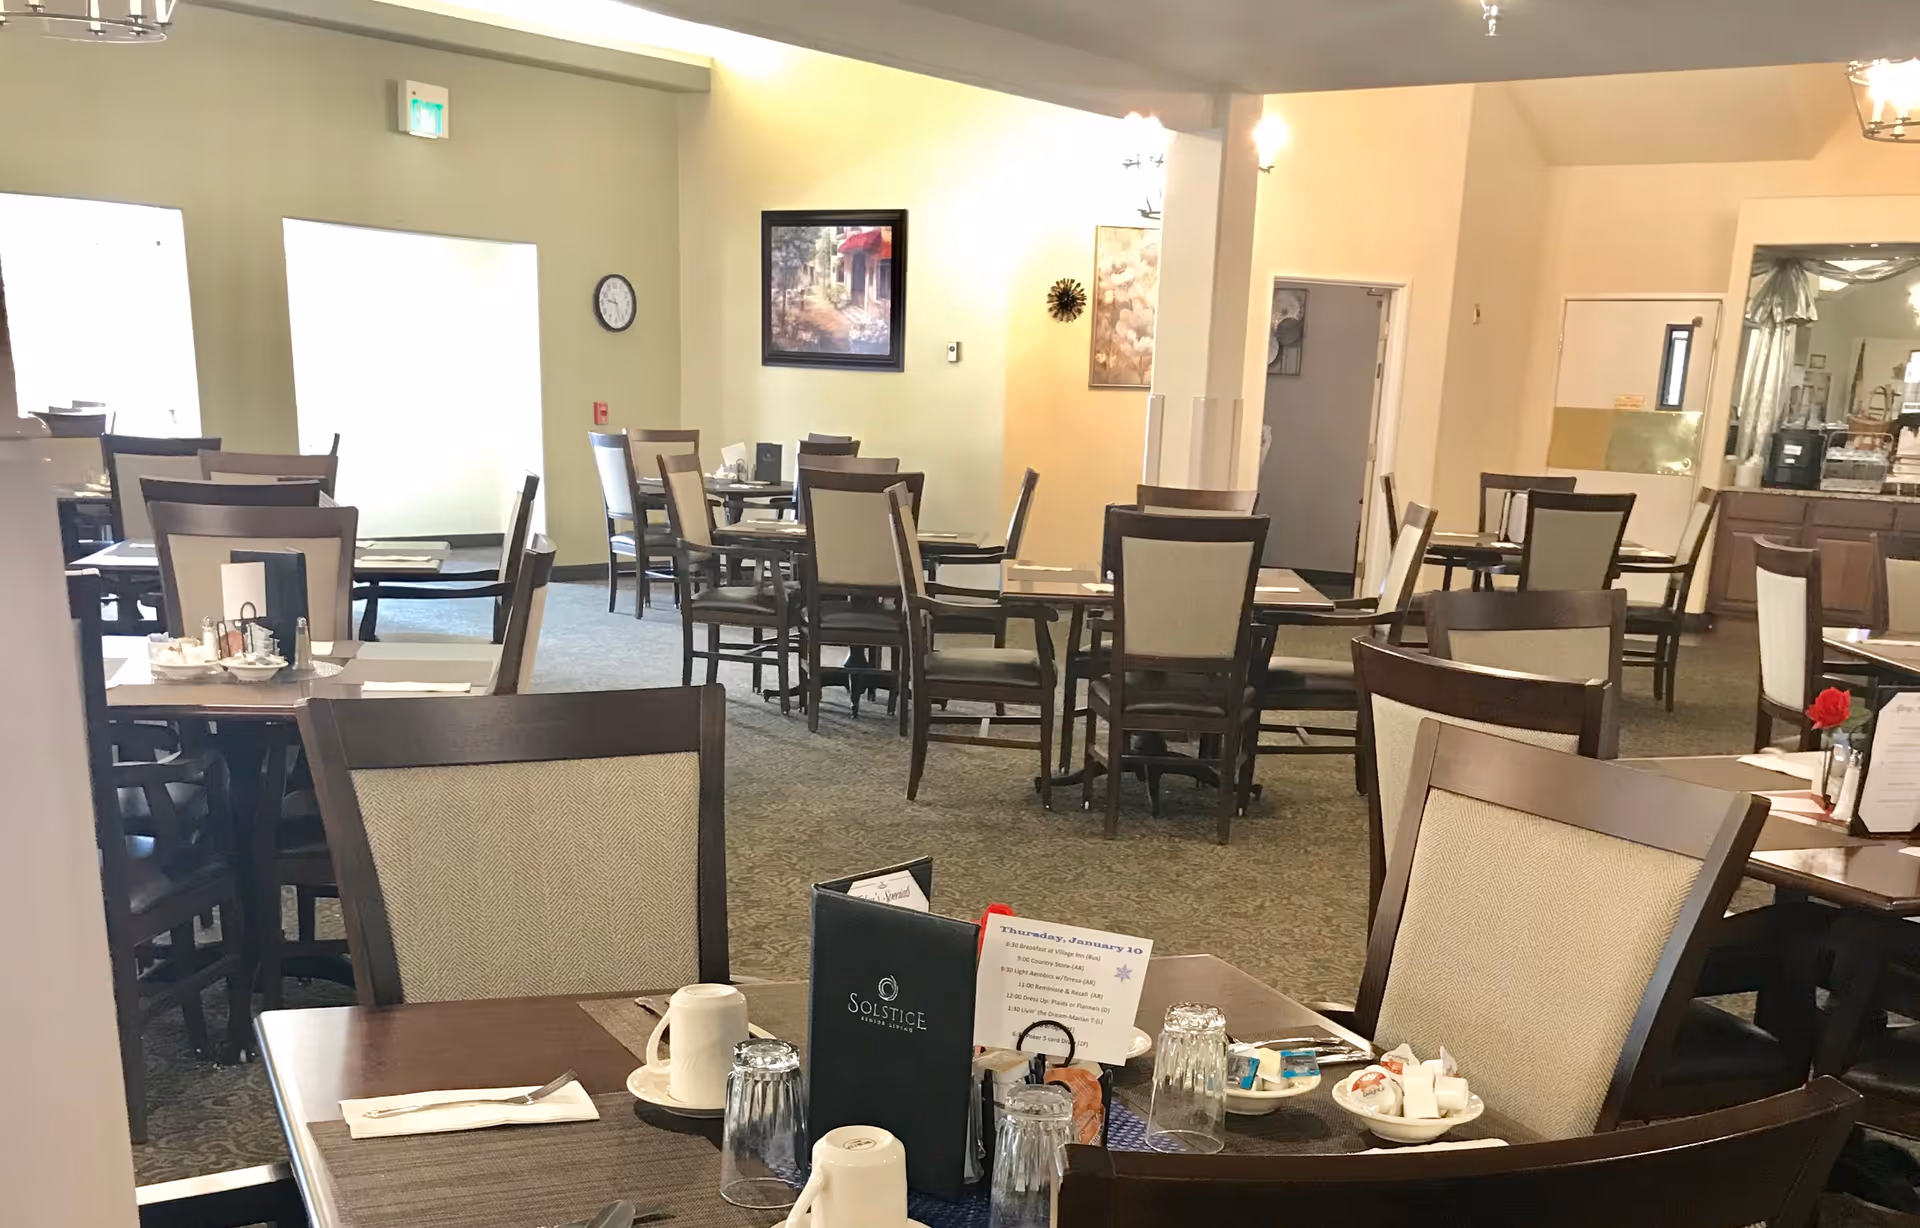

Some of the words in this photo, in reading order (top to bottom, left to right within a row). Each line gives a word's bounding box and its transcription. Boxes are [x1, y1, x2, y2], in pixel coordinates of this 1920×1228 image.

[1000, 925, 1066, 943] Thursday,
[1069, 937, 1124, 953] January
[1126, 946, 1144, 955] 10
[1019, 943, 1046, 953] Breakfast
[1055, 949, 1074, 957] Village
[1031, 958, 1054, 968] Country
[1014, 967, 1028, 976] Light
[1029, 971, 1054, 980] Aerobics
[1035, 984, 1063, 994] Reminisce
[847, 992, 928, 1030] SOLSTICE
[1023, 995, 1038, 1003] Dress
[1076, 1003, 1100, 1012] Flannels
[860, 1016, 886, 1026] SENIOR
[888, 1023, 914, 1033] LIVING
